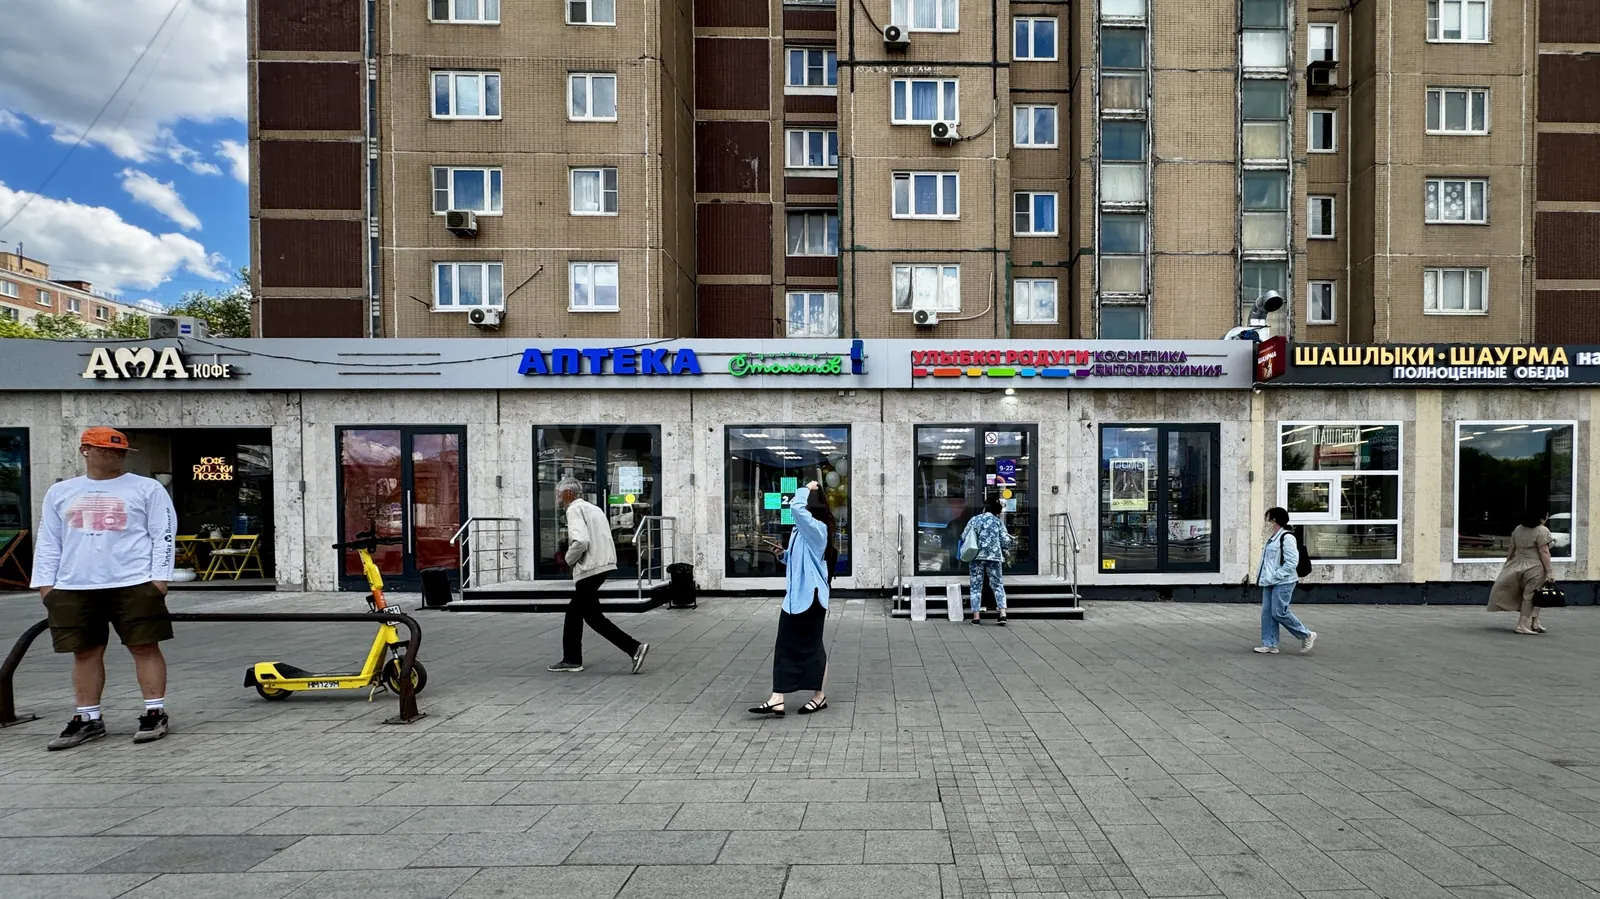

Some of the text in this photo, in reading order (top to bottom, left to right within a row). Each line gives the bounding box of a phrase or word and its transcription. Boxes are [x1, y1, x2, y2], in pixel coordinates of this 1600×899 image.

[518, 348, 703, 376] АПТЕКА
[1093, 350, 1188, 363] КОСМЕТИКА
[1295, 346, 1435, 366] ШАШЛЫКИ
[1450, 346, 1569, 366] ШАУРМА
[193, 353, 230, 378] КОФЕ
[728, 354, 842, 377] Столетов
[1093, 364, 1224, 377] БЫТОВАЯ ХИМИЯ
[1393, 366, 1570, 381] ПОЛНОЦЕННЫЕ ОБЕДЫ
[200, 456, 226, 465] КОФЕ
[192, 464, 233, 473] БУЛЧКИ
[192, 472, 233, 481] ЛЮБОВЬ
